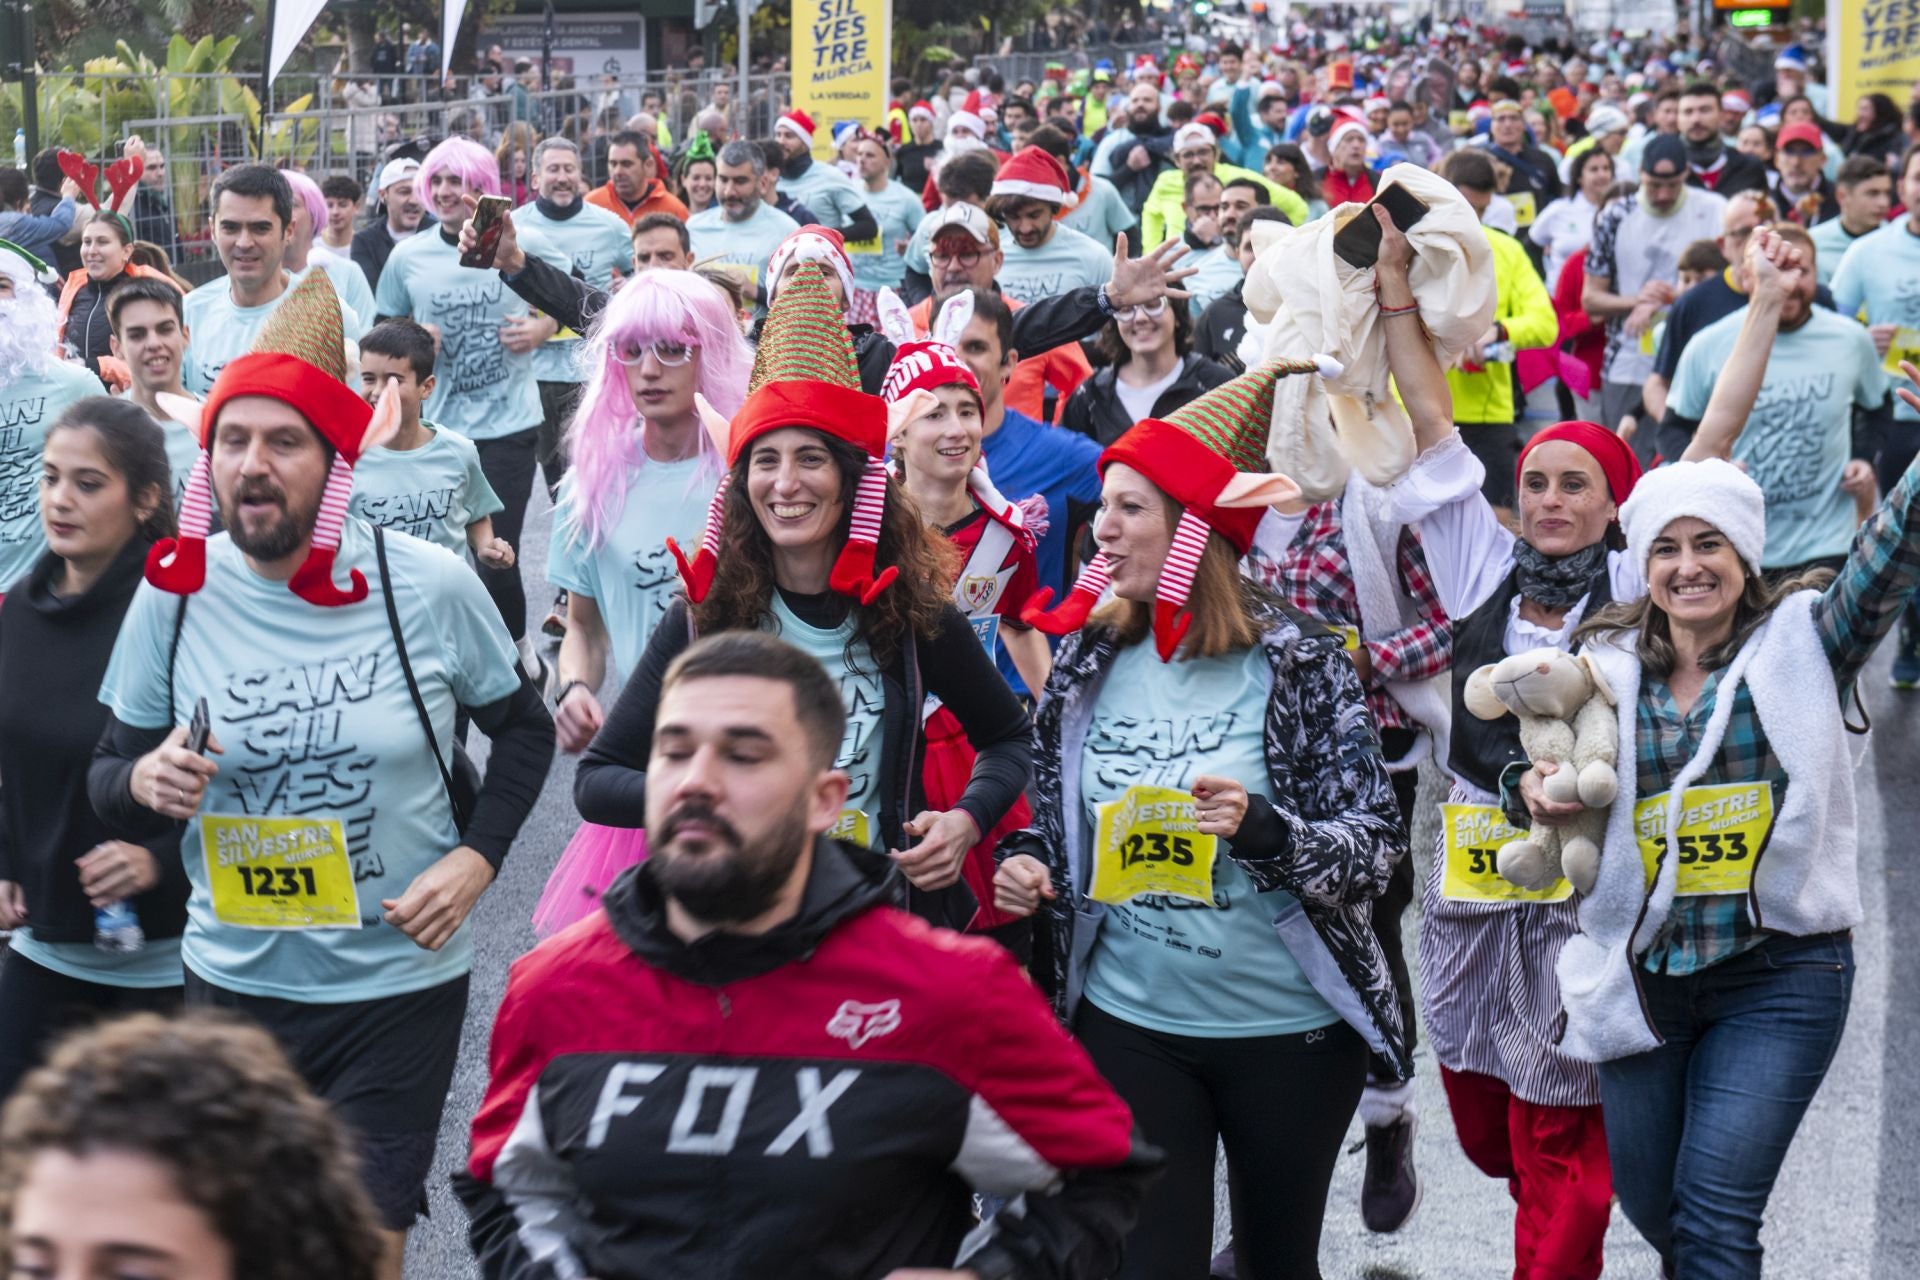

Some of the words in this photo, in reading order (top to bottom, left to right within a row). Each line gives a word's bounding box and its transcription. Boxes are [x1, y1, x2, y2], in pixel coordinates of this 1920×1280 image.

[818, 0, 860, 22] SIL
[813, 15, 865, 44] VES
[814, 39, 868, 67] TRE
[812, 59, 873, 83] MURCIA
[810, 91, 824, 101] LA
[827, 91, 871, 101] VERDAD
[361, 489, 454, 527] SAN
[222, 653, 380, 724] SAN
[238, 709, 358, 775] SIL
[1085, 711, 1239, 761] SAN
[228, 757, 378, 816] VES
[216, 823, 260, 847] SAN
[1161, 822, 1198, 833] MURC
[1455, 812, 1491, 831] SAN
[1456, 820, 1520, 848] SILVES
[1709, 810, 1759, 832] MURCIA
[218, 825, 333, 867] SILVESTRE
[284, 844, 335, 864] MURCIA
[1120, 832, 1194, 870] 1235
[1654, 832, 1748, 864] 2533
[1468, 848, 1499, 874] 31
[237, 866, 317, 896] 1231
[585, 1061, 863, 1158] FOX
